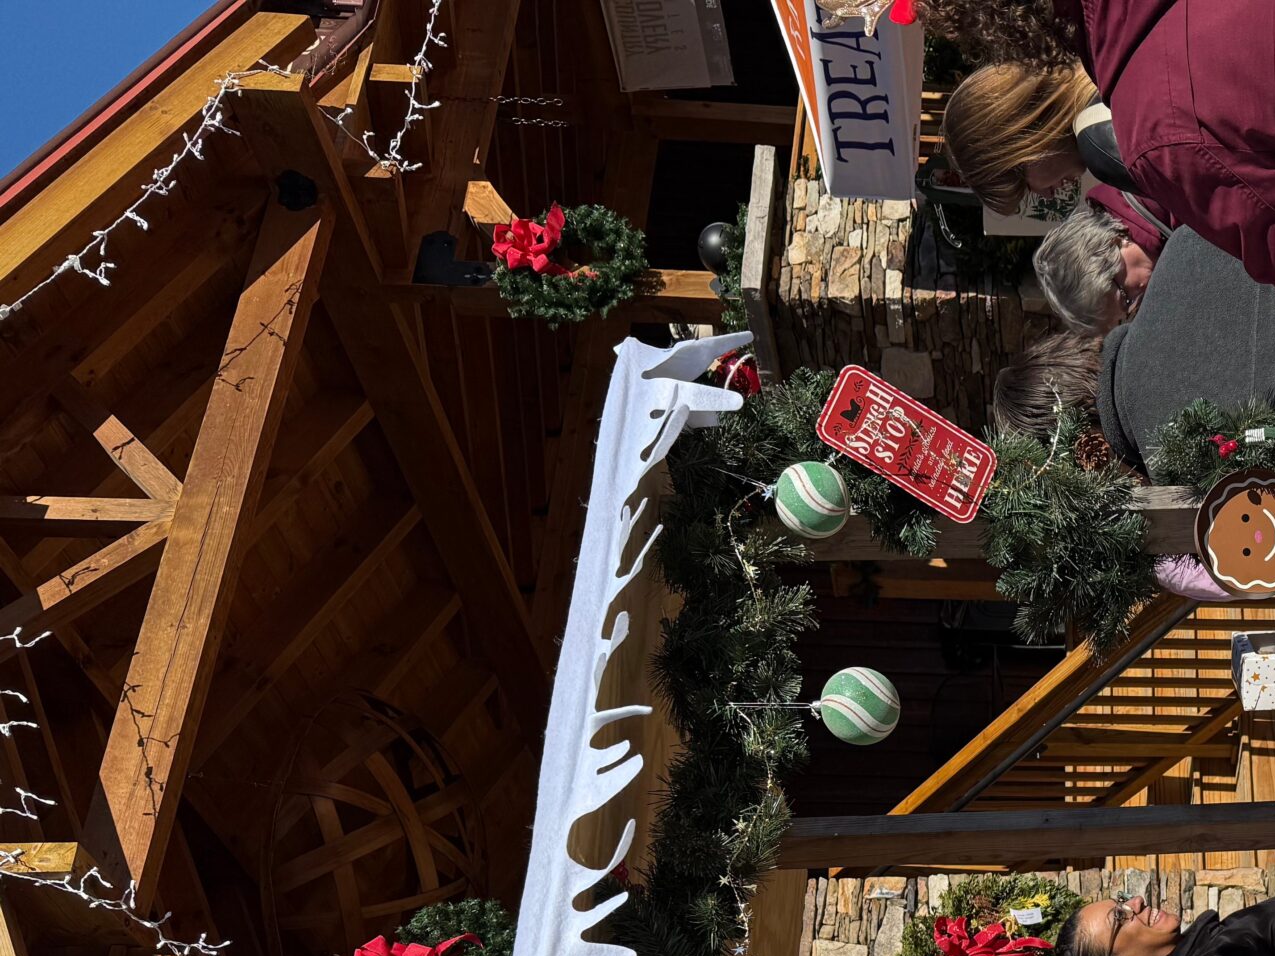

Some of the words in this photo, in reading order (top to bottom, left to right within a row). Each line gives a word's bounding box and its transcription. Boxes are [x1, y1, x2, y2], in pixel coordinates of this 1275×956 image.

[844, 382, 894, 455] SLEIGH
[874, 406, 906, 463] STOP
[943, 446, 984, 510] HERE
